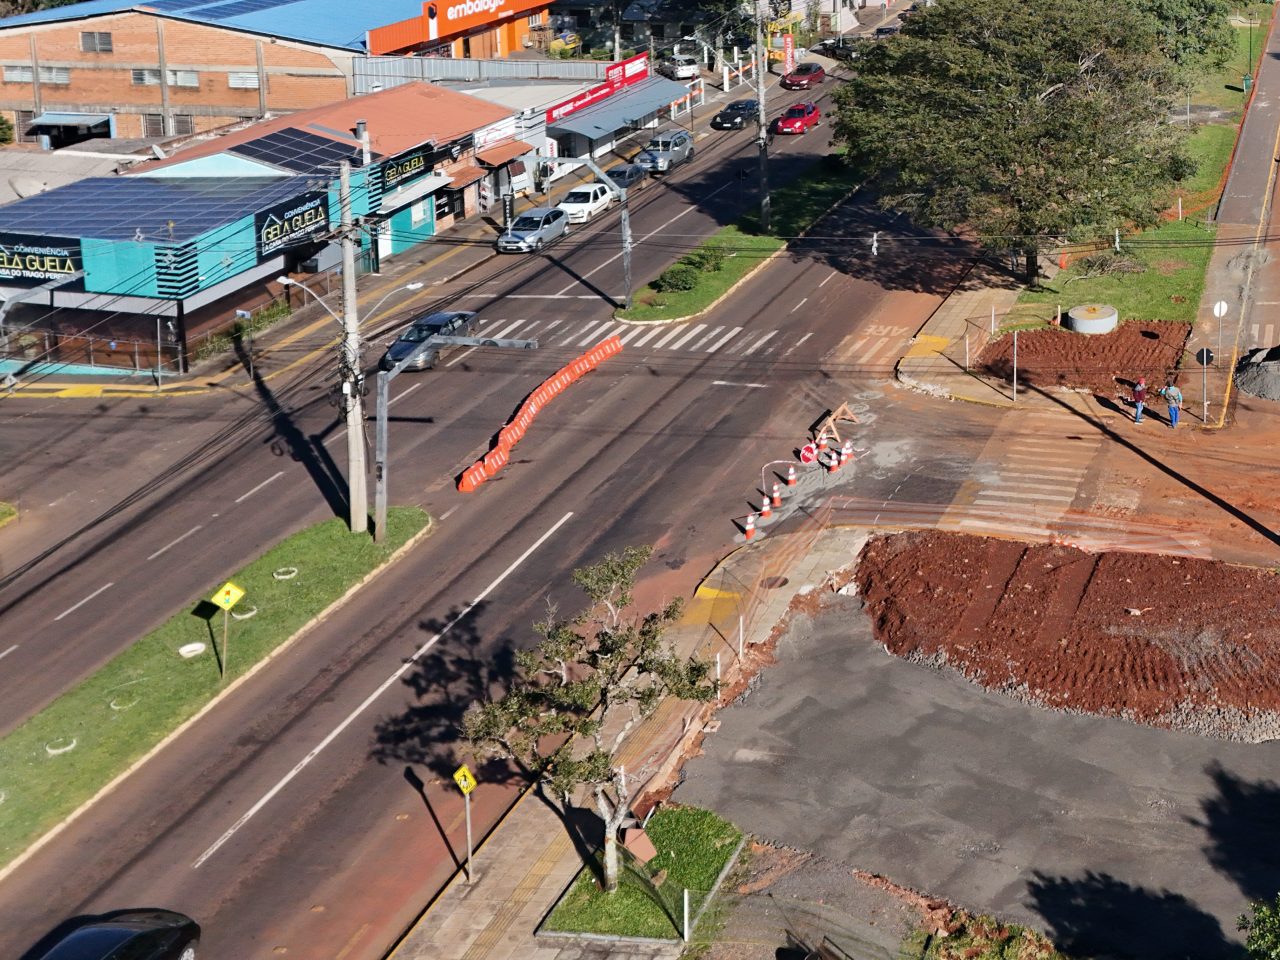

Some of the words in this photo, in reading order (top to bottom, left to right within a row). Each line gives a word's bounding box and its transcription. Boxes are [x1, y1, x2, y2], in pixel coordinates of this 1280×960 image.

[263, 221, 291, 244] GELA
[292, 206, 325, 231] GUELA
[14, 245, 69, 256] CONVENIÊNCIA
[26, 255, 75, 273] GUELA
